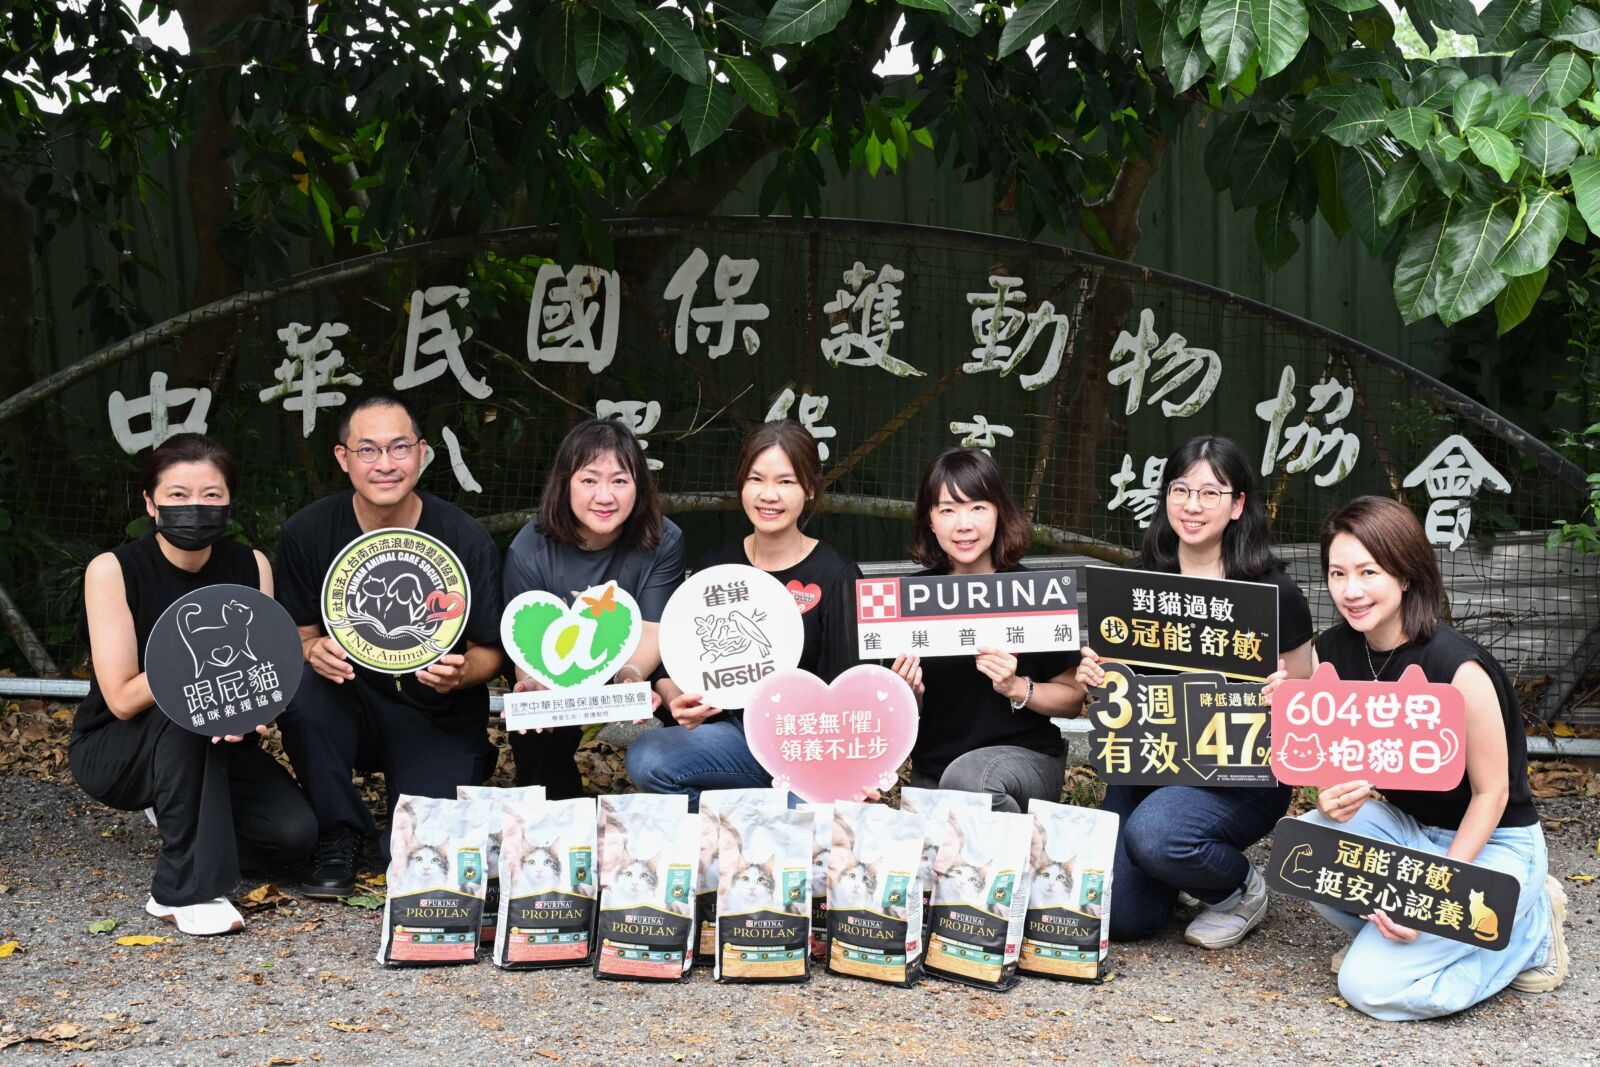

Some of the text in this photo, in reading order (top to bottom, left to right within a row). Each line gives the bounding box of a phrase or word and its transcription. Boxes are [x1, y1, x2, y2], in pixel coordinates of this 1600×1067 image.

[347, 551, 445, 595] TAINAN ANIMAL CARE SOCIETY
[702, 580, 750, 607] 雀巢
[1132, 588, 1235, 623] 對貓過敏
[863, 624, 1073, 651] 雀巢普瑞納
[183, 661, 279, 714] 跟屁貓
[1097, 671, 1176, 729] 3週
[191, 690, 283, 727] 貓咪救援協會
[1286, 691, 1441, 730] 604世界
[775, 710, 882, 737] 讓愛無「懼」
[780, 738, 889, 762] 領養不止步
[1097, 732, 1180, 774] 有效
[1329, 737, 1441, 774] 抱貓日
[1314, 867, 1466, 931] 挺安心認養
[406, 907, 433, 917] PRO
[436, 907, 469, 918] PLAN
[522, 909, 582, 919] PRO PLAN
[633, 916, 661, 924] PURINA
[854, 918, 880, 928] PURINA
[956, 913, 982, 924] PURINA
[1049, 916, 1076, 926] PURINA
[612, 922, 676, 936] PRO PLAN
[733, 928, 795, 938] PRO PLAN
[838, 922, 860, 935] PRO
[861, 928, 894, 939] PLAN
[940, 917, 996, 937] PRO PLAN
[1030, 921, 1089, 937] PRO PLAN
